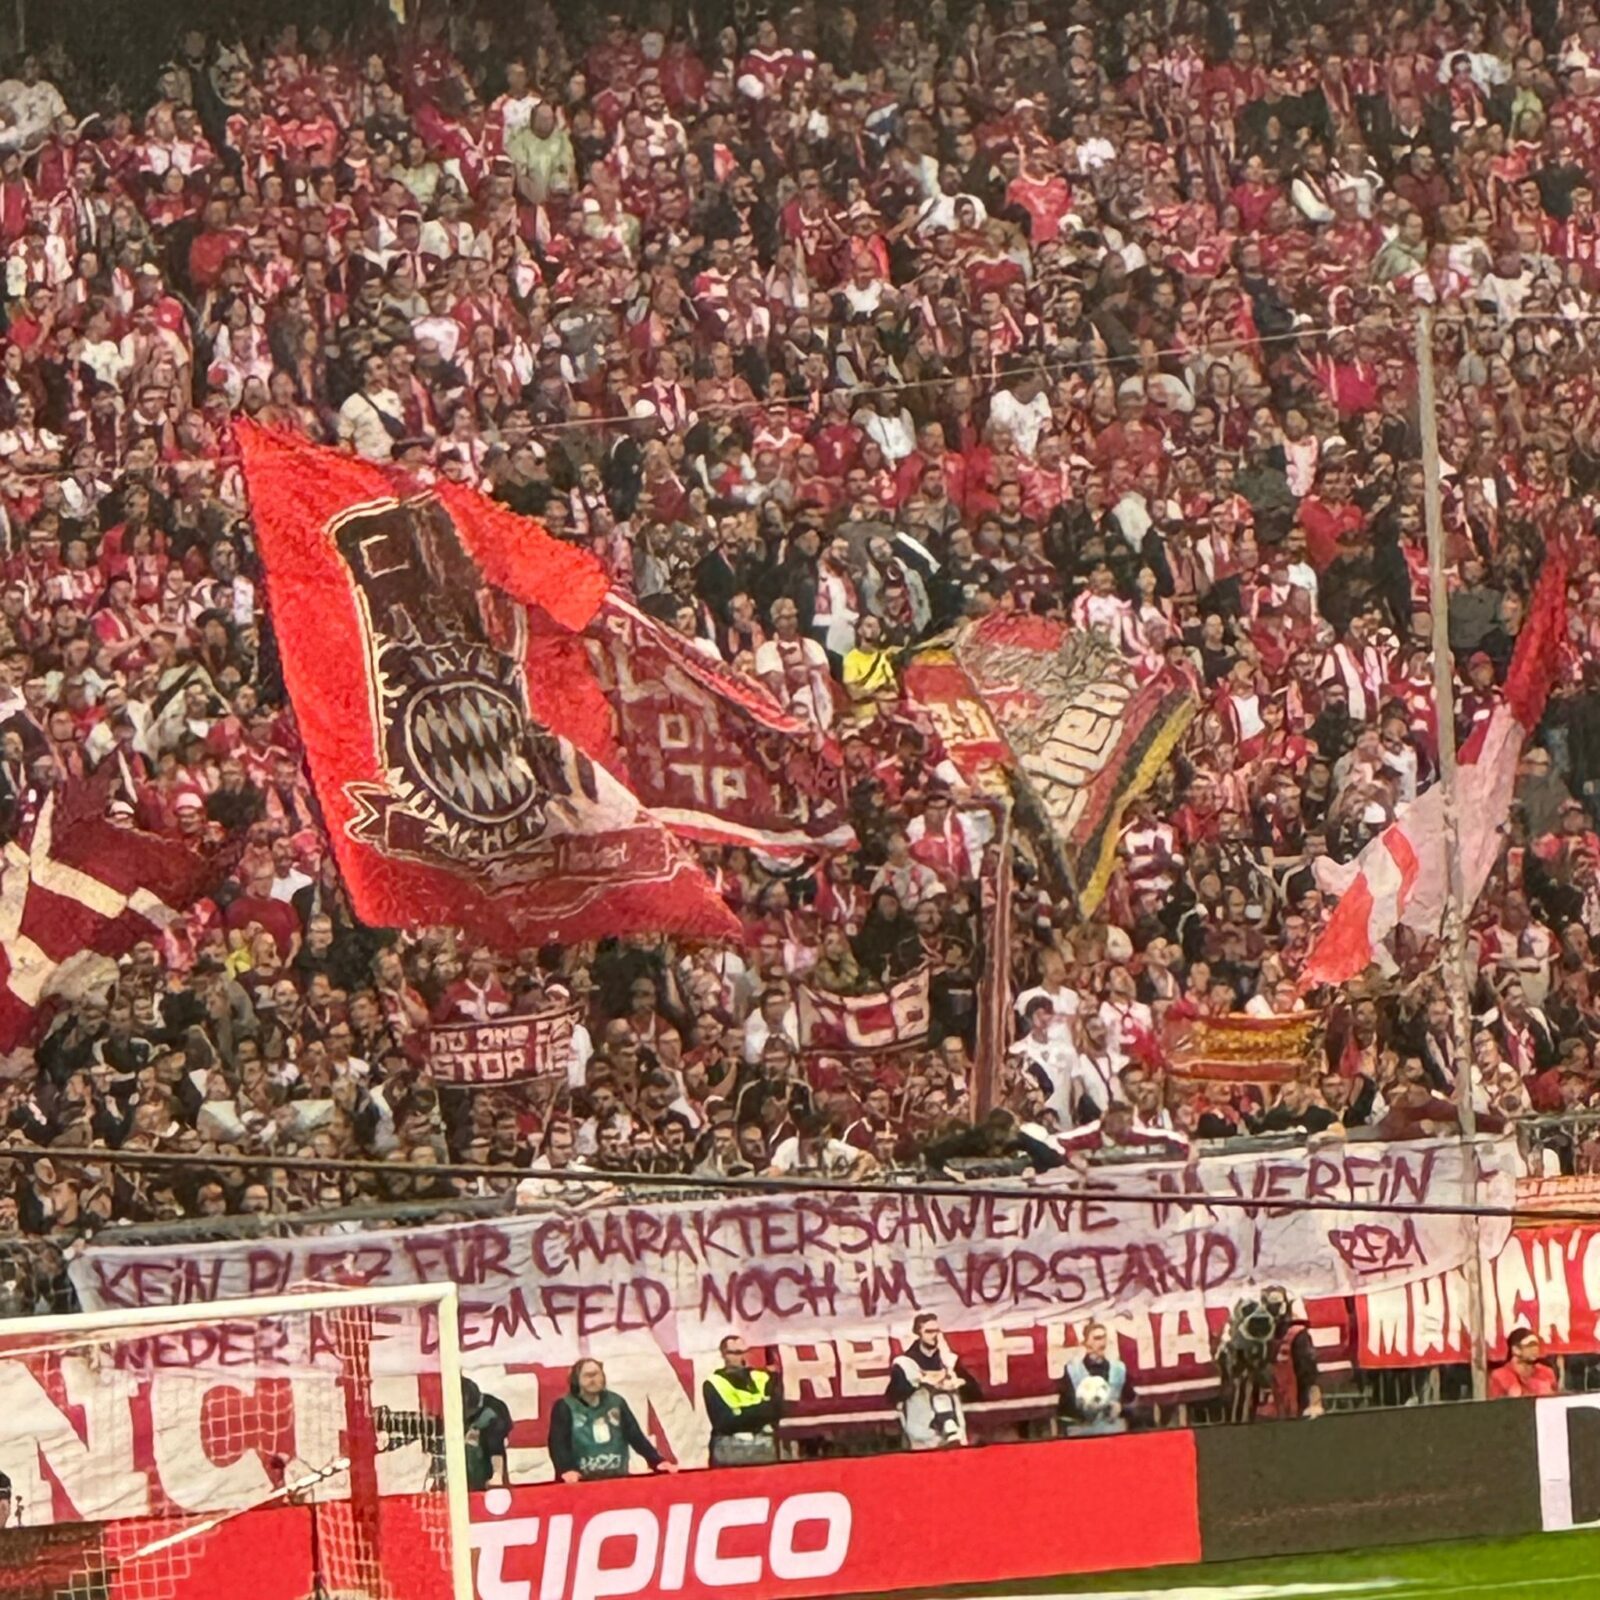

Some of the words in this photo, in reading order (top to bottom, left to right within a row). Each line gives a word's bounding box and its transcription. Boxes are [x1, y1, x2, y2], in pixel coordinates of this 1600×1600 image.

[404, 1224, 520, 1285] FÜR
[700, 1260, 839, 1323] NOCH
[469, 1488, 853, 1600] tipico
